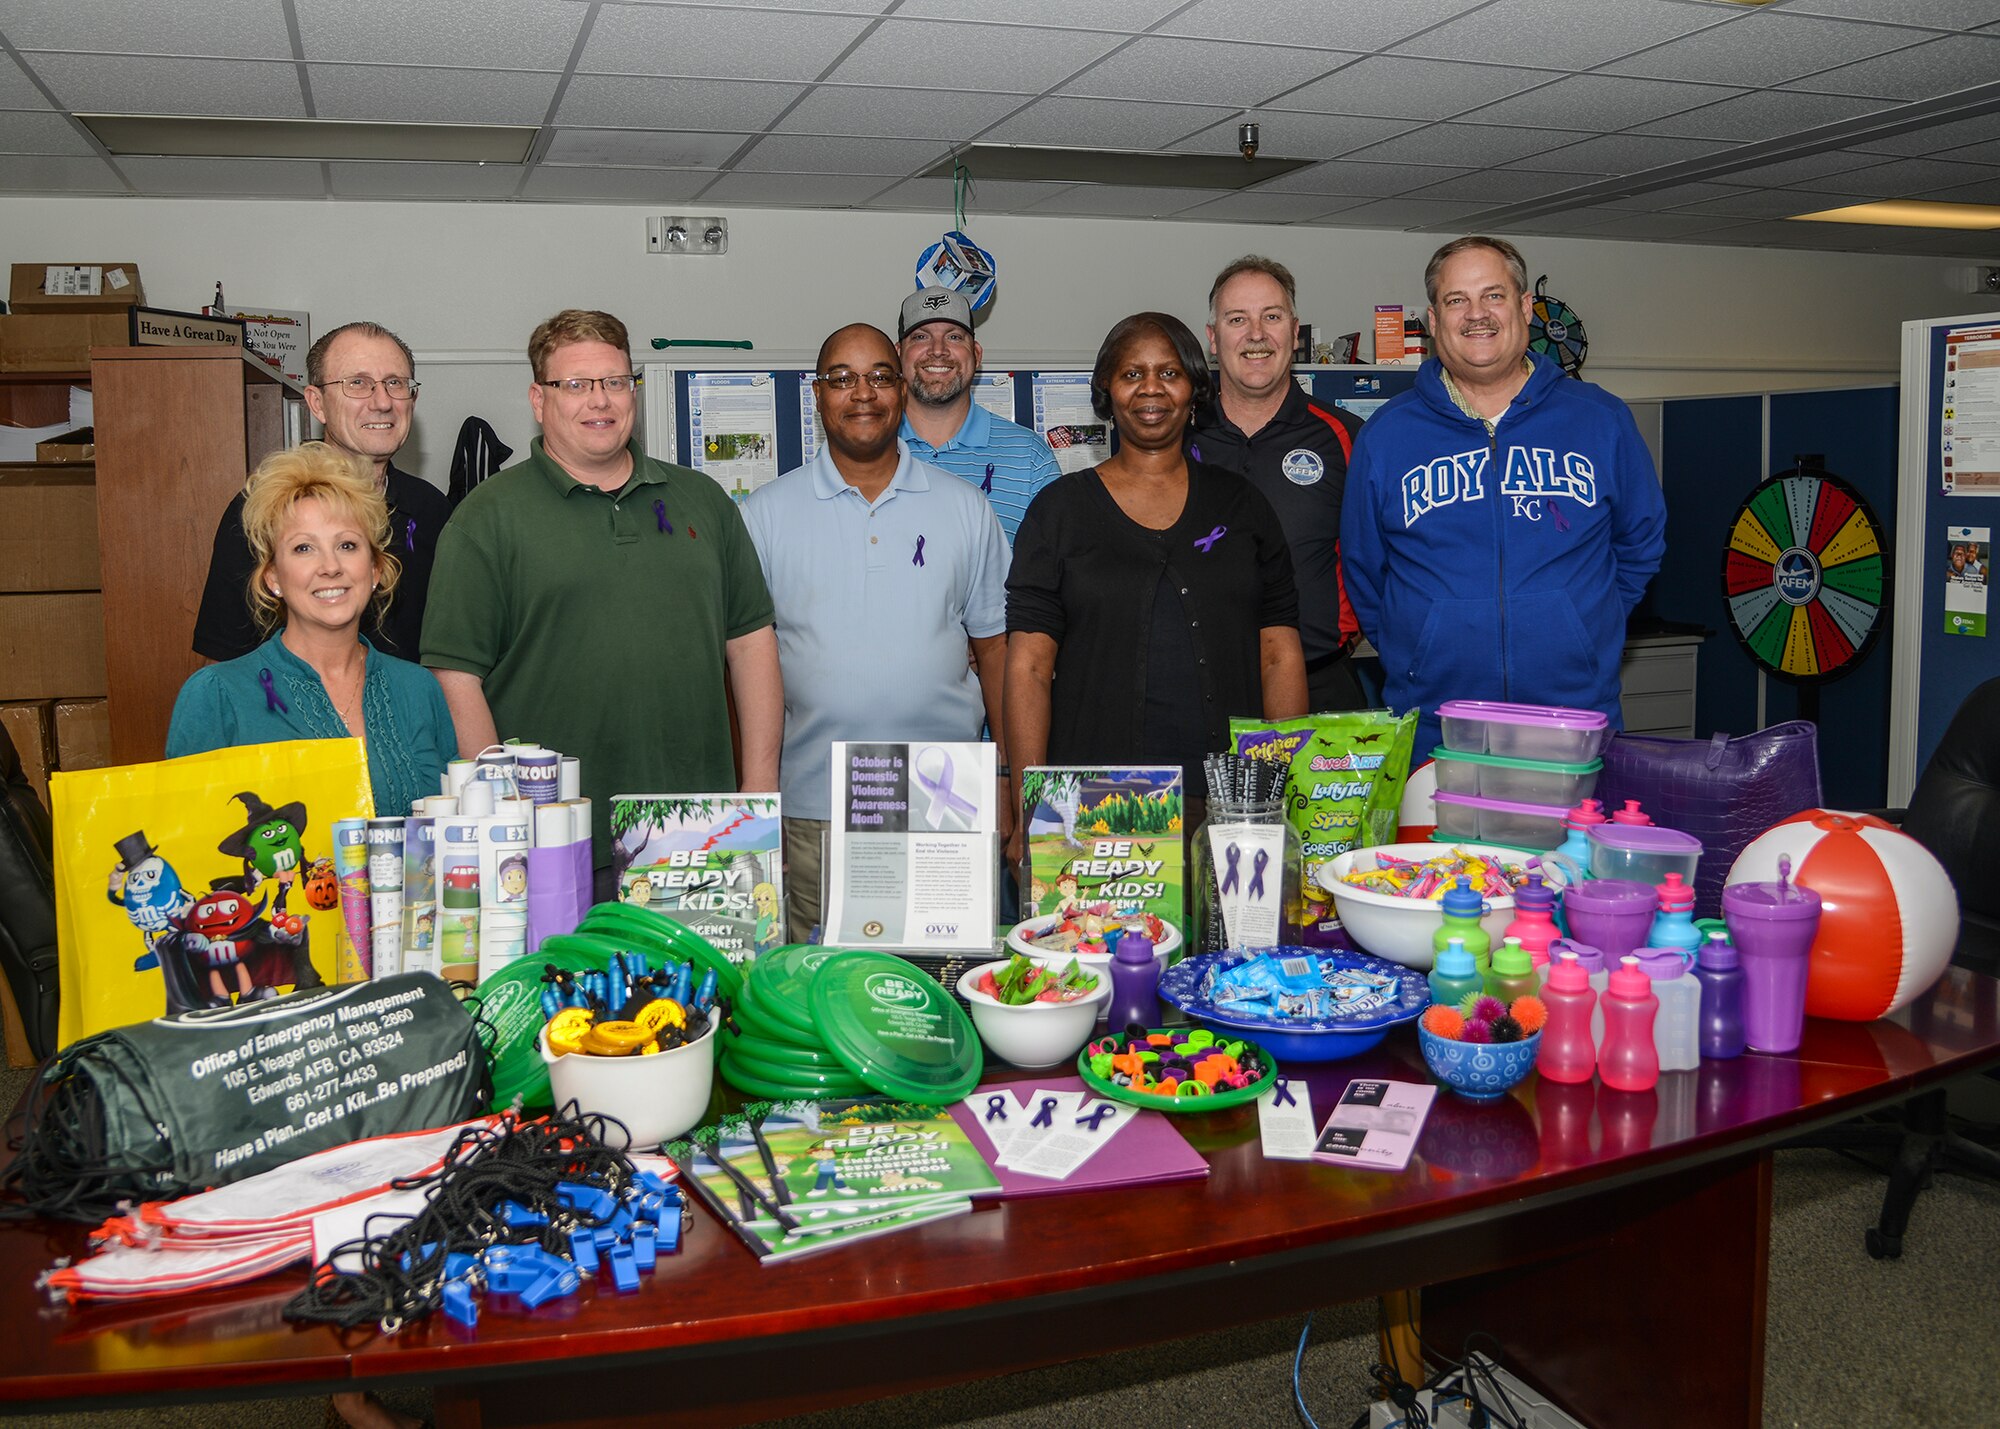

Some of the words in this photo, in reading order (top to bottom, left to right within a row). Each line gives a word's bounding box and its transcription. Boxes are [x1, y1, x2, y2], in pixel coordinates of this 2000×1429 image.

[140, 321, 170, 338] Have
[173, 325, 181, 338] A
[184, 326, 214, 342] Great
[217, 329, 238, 346] Day
[253, 328, 268, 337] Not
[270, 330, 290, 340] Open
[1964, 333, 1992, 341] TERRORISM
[262, 341, 276, 349] You
[278, 341, 297, 351] Were
[1288, 467, 1318, 476] AFEM
[1511, 496, 1543, 522] KC
[1780, 577, 1814, 589] AFEM
[852, 756, 891, 768] October
[893, 756, 903, 768] is
[485, 765, 515, 780] EAR
[518, 765, 559, 780] CKOUT
[852, 770, 899, 782] Domestic
[851, 784, 895, 796] Violence
[851, 798, 907, 810] Awareness
[851, 812, 884, 824] Month
[1310, 811, 1360, 830] Spre
[1093, 841, 1132, 858] BE
[669, 850, 709, 868] BE
[1071, 860, 1163, 877] READY
[647, 870, 742, 888] READY
[1098, 882, 1165, 898] KIDS!
[677, 892, 755, 911] KIDS!
[925, 925, 959, 934] OVW
[884, 979, 904, 989] BE
[876, 986, 923, 1000] READY
[191, 1049, 238, 1079] Office
[239, 1038, 254, 1060] of
[254, 1012, 335, 1054] Emergency
[337, 986, 426, 1022] Management
[222, 1067, 248, 1090] 105
[247, 1062, 262, 1081] E.
[259, 1046, 306, 1074] Yeager
[307, 1031, 347, 1056] Blvd.,
[346, 1021, 382, 1041] Bldg.
[380, 1008, 414, 1029] 2860
[247, 1072, 303, 1105] Edwards
[304, 1057, 339, 1082] AFB,
[338, 1047, 362, 1067] CA
[361, 1030, 404, 1058] 93524
[285, 1064, 378, 1114] 661-277-4433
[215, 1142, 254, 1169] Have
[254, 1137, 266, 1154] a
[334, 1103, 344, 1118] a
[400, 1050, 467, 1091] Prepared!
[849, 1124, 895, 1137] BE
[823, 1131, 941, 1149] READY
[865, 1141, 949, 1157] KIDS!
[834, 1157, 946, 1172] PREPAREDNESS
[842, 1151, 929, 1164] EMERGENCY
[908, 1163, 951, 1173] BOOK
